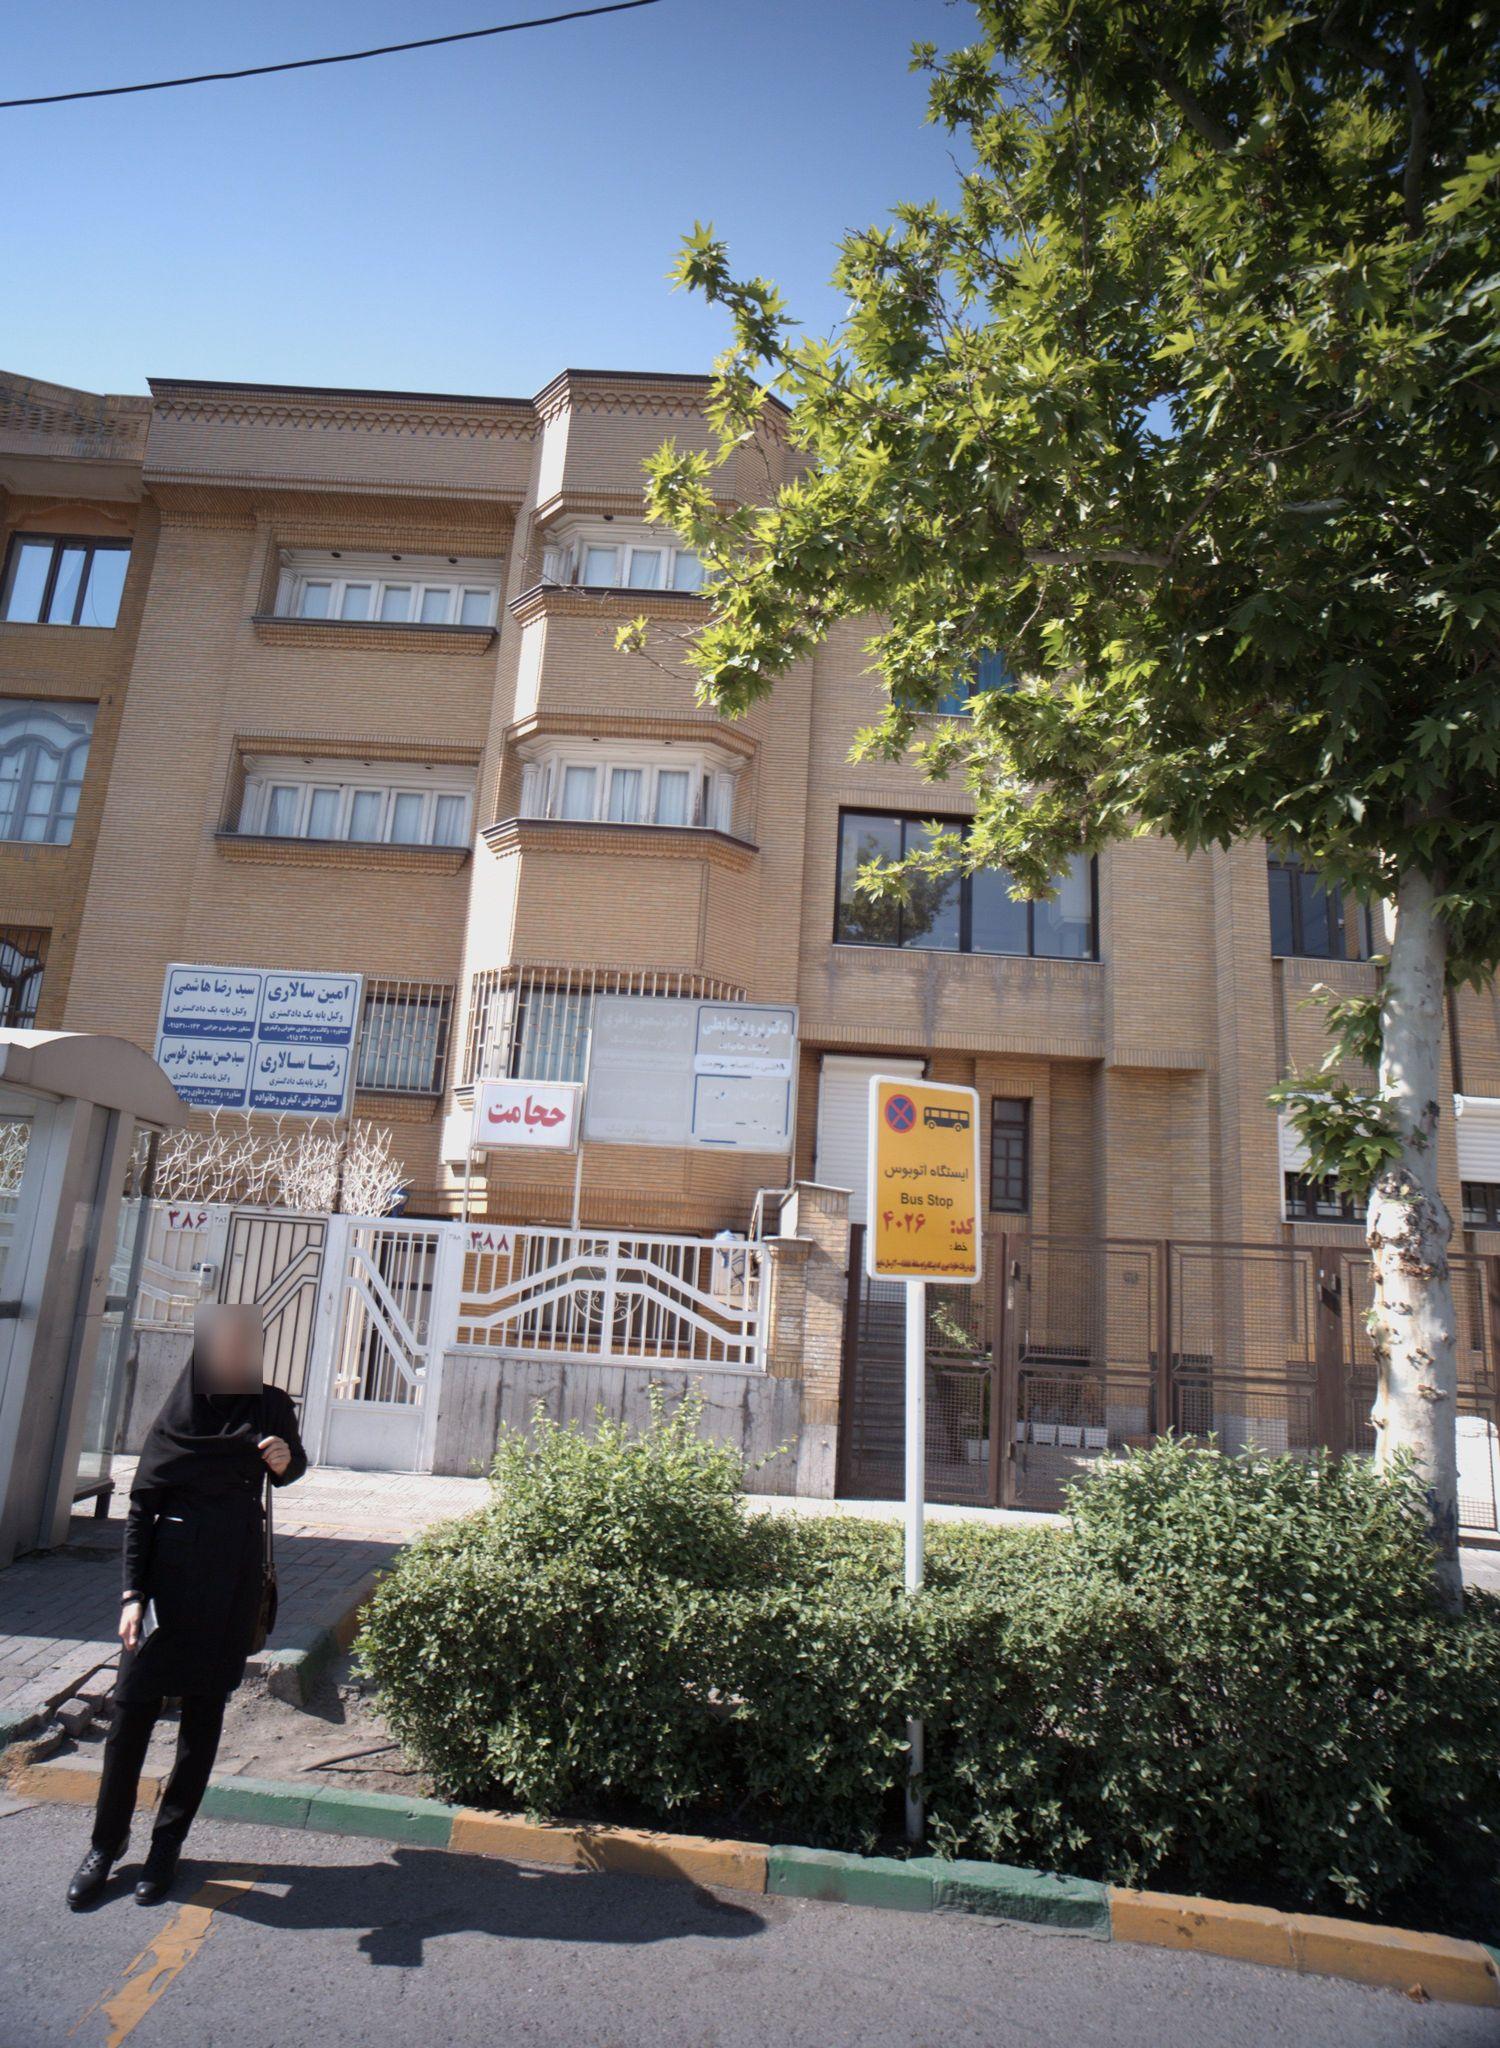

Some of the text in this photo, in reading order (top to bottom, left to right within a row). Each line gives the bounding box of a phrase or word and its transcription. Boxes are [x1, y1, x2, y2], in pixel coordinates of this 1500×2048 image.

[174, 978, 255, 998] سید رضا هاشمی
[268, 981, 350, 1004] امین سالاری
[173, 1004, 246, 1016] وکیل پایه یک دادگستری
[269, 1009, 343, 1022] وکیل پایه یک دادگستری
[164, 1045, 245, 1067] سید حسن سعیدی طوسی
[260, 1051, 340, 1077] رضا سالاری
[173, 1071, 198, 1080] دادگستری
[208, 1074, 216, 1082] پایه
[217, 1074, 230, 1083] وکیل
[269, 1077, 327, 1088] وکیل پایه یک دادگستری
[488, 1094, 566, 1133] حجامت
[884, 1164, 968, 1182] ایستگاه اتوبوس
[901, 1192, 954, 1209] Bus Stop
[169, 1211, 207, 1229] ۳۸۶
[883, 1211, 975, 1234] کد: ۴۰۲۶
[471, 1231, 509, 1251] ۳۸۸
